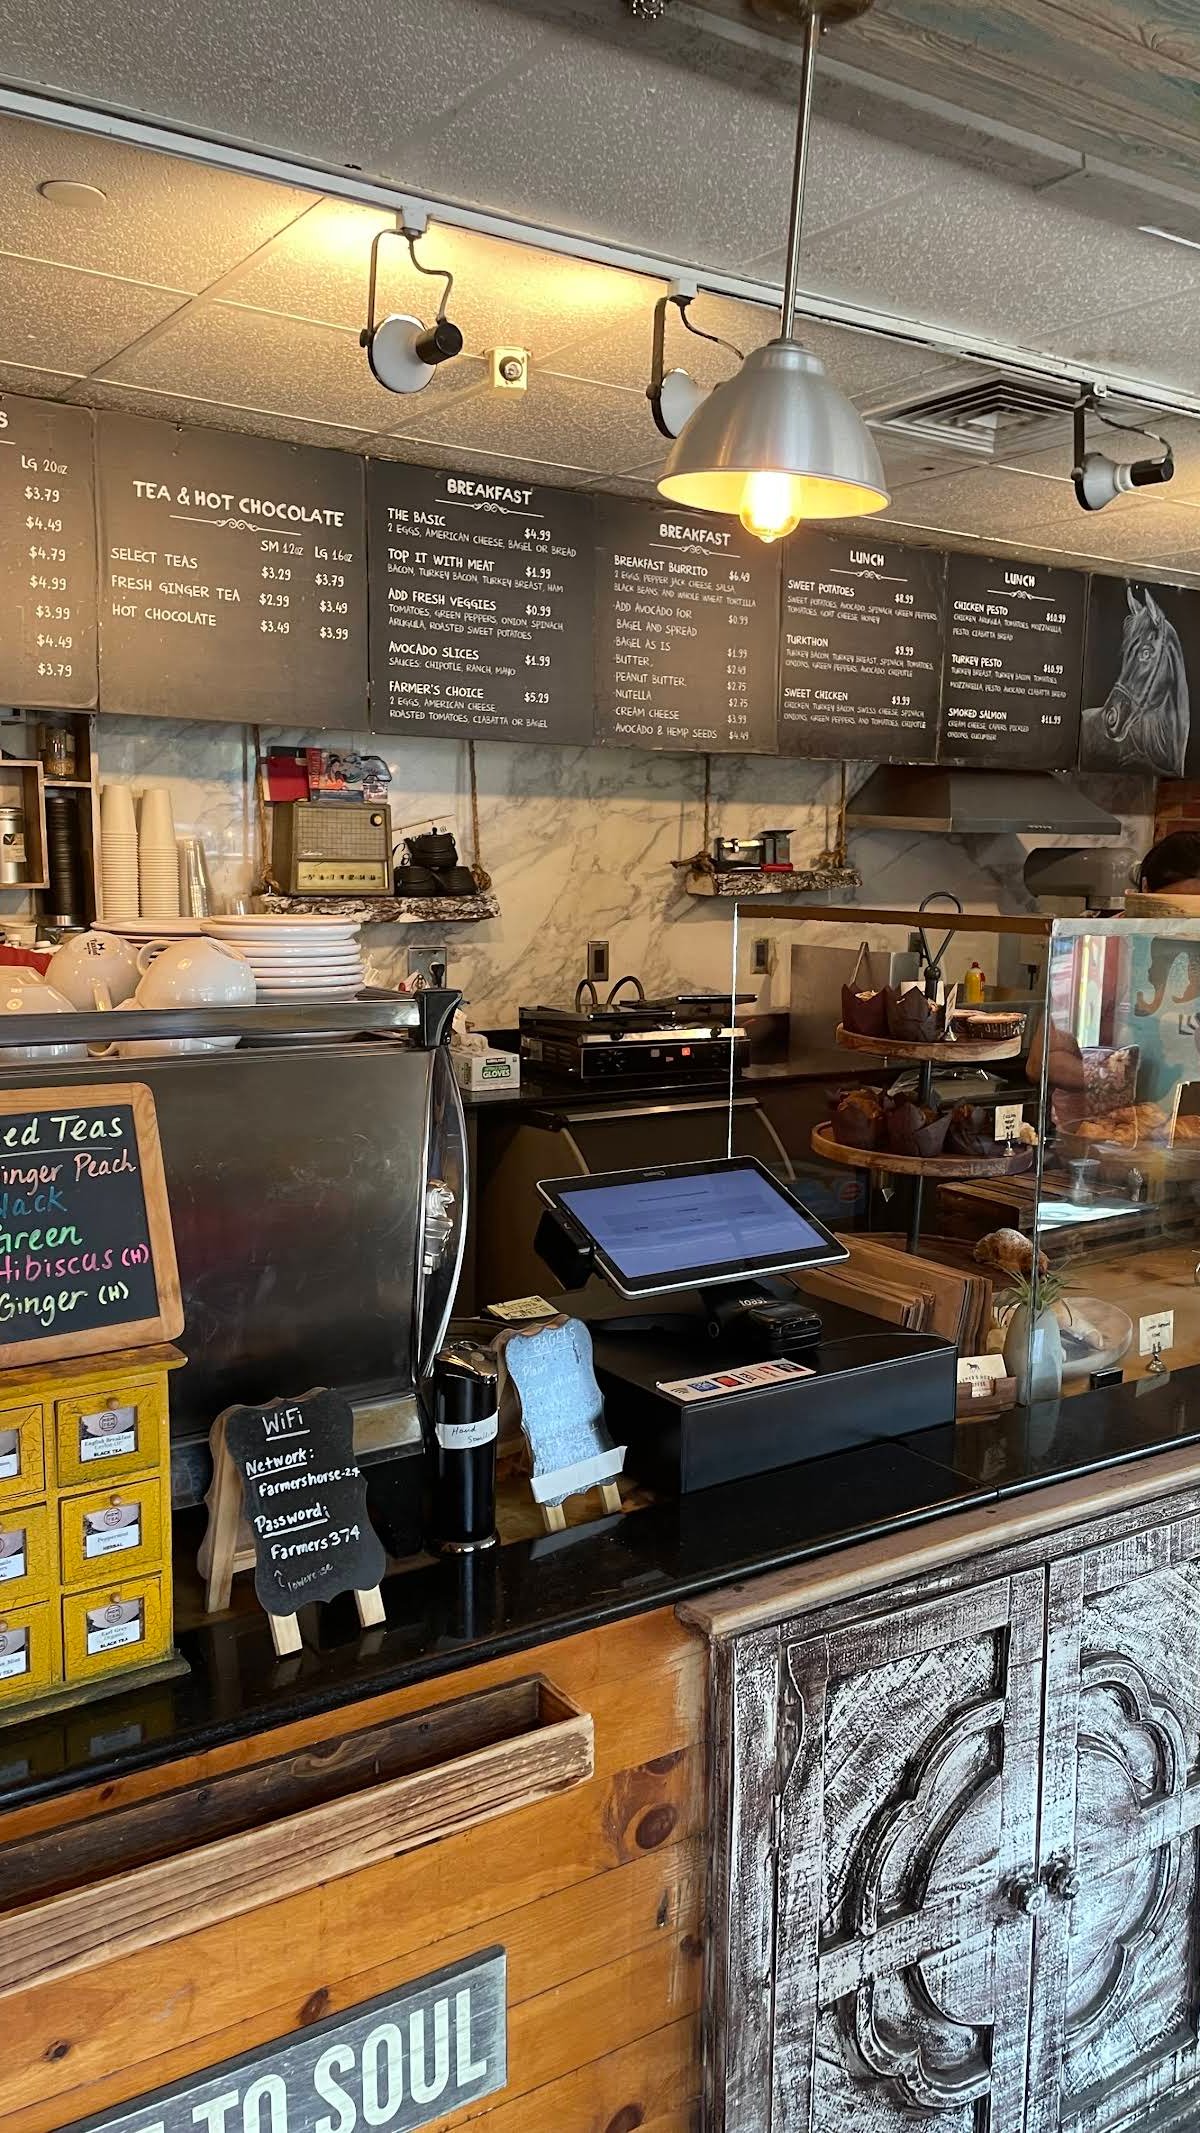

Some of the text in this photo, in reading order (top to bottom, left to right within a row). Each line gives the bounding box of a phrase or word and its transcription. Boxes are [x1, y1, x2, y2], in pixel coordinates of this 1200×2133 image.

[22, 455, 68, 474] LG 20oz
[25, 486, 60, 502] $3.79
[447, 479, 532, 505] BREAKFAST
[133, 480, 345, 527] TEA & HOT CHOCOLATE
[26, 517, 62, 532] $4.49
[388, 508, 446, 526] THE BASIC
[388, 523, 393, 532] 2
[425, 528, 469, 542] AMERICAN
[509, 540, 532, 551] BAGEL
[536, 545, 547, 553] OR
[552, 546, 576, 557] BREAD
[524, 528, 550, 541] $4.99
[660, 523, 731, 546] BREAKFAST
[29, 546, 65, 561] $4.79
[261, 540, 280, 553] SM
[315, 546, 328, 561] LG
[111, 548, 198, 569] SELECT TEAS
[388, 548, 494, 572] TOP IT WITH MEAT
[614, 555, 708, 576] BREAKFAST BURRITO
[850, 550, 884, 566] LUNCH
[262, 566, 291, 581] $3.29
[315, 573, 344, 588] $3.79
[420, 567, 449, 580] TURKEY
[483, 576, 512, 588] TURKEY
[526, 567, 551, 579] $1.99
[729, 571, 750, 582] $6.49
[1005, 572, 1035, 587] LUNCH
[30, 575, 67, 590] $4.99
[112, 575, 240, 602] FRESH GINGER TEA
[644, 574, 685, 588] PEPPER JACK
[788, 580, 855, 597] SWEET POTATOES
[259, 593, 289, 608] $2.99
[388, 588, 496, 610] ADD FRESH VEGGIES
[614, 583, 756, 607] BLACK BEANS AND WHOLE WHEAT TORTILLA
[788, 596, 807, 604] SWEET
[36, 606, 70, 620] $3.99
[112, 604, 216, 626] HOT CHOCOLATE
[320, 600, 347, 615] $3.49
[435, 609, 460, 619] GREEN
[526, 605, 551, 617] $0.99
[635, 603, 672, 617] AVOCADO
[677, 609, 692, 618] FOR
[954, 601, 1008, 615] CHICKEN PESTO
[260, 620, 289, 634] $3.49
[729, 615, 748, 625] $0.99
[320, 626, 349, 641] $3.99
[430, 622, 532, 640] ROASTED SWEET POTATOES
[617, 619, 697, 637] BAGEL AND SPREAD
[37, 634, 72, 649] $4.49
[615, 637, 671, 651] BAGEL AS IS
[787, 634, 828, 647] TURKTHON
[389, 641, 479, 660] AVOCADO SLICES
[728, 649, 747, 657] $1.99
[525, 655, 550, 666] $1.99
[952, 654, 1002, 667] TURKEY PESTO
[38, 663, 72, 677] $3.79
[615, 672, 648, 682] PEANUT
[389, 681, 484, 698] FARMER'S CHOICE
[615, 689, 652, 700] NUTELLA
[784, 688, 848, 700] SWEET CHICKEN
[389, 696, 464, 710] 2 AMERICAN
[524, 692, 549, 703] $5.29
[390, 709, 425, 720] ROASTED
[473, 715, 508, 726] CIABATTA
[526, 719, 547, 728] BAGEL
[615, 707, 680, 719] CREAM CHEESE
[857, 707, 876, 715] SWISS
[948, 708, 1007, 720] SMOKED SALMON
[615, 723, 717, 739] AVOCADO HEMP SEEDS
[483, 1070, 509, 1078] GLOVES
[50, 1115, 123, 1142] Teas
[74, 1149, 137, 1182] Peach
[0, 1186, 67, 1218] lack
[122, 1243, 150, 1267] (H)
[0, 1281, 129, 1327] Ginger (H)
[533, 1328, 575, 1352] BAGELS
[262, 1407, 303, 1435] WiFi
[246, 1448, 315, 1476] Network:
[288, 1563, 334, 1592] lowercse
[314, 1988, 487, 2133] SOUL
